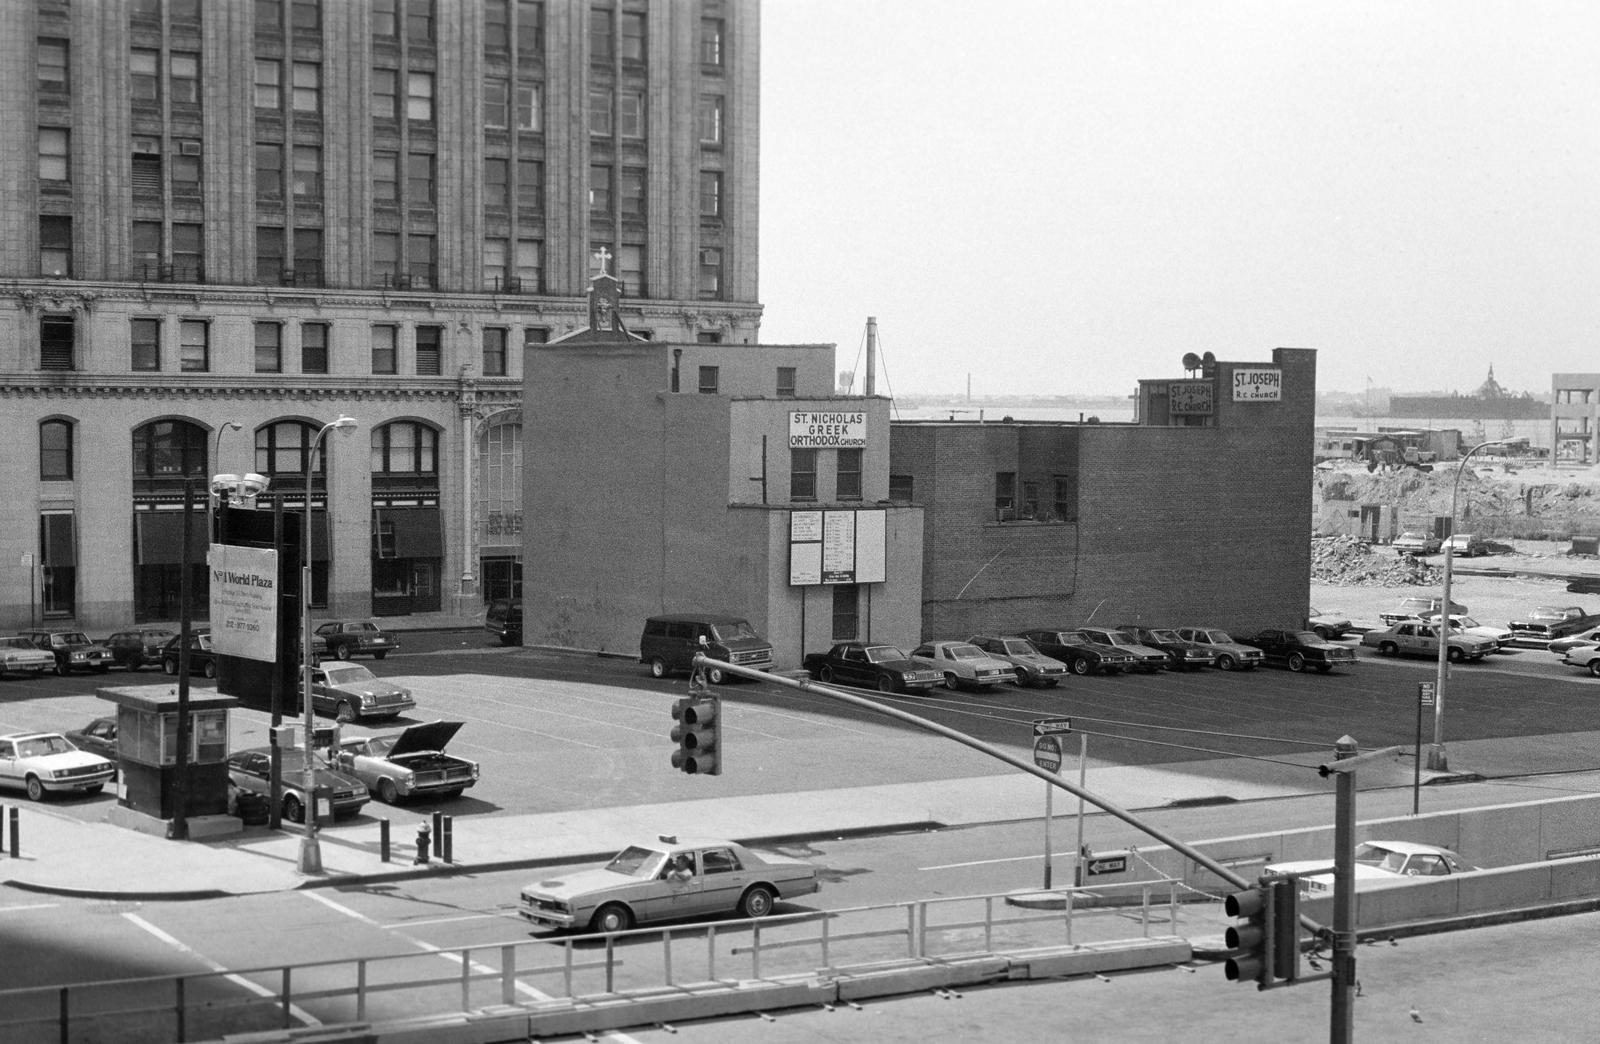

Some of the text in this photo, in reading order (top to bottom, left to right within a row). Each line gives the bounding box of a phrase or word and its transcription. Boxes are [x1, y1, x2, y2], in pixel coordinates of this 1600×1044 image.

[1247, 372, 1280, 388] JOSEPH
[1182, 385, 1212, 398] JOSEPH
[1250, 390, 1278, 399] CHURCH
[1184, 400, 1212, 412] CHURCH
[794, 413, 863, 424] ST. NICHOLAS
[808, 425, 849, 435] GREEK
[790, 435, 866, 446] ORTHODOX CHURCH
[228, 572, 250, 586] World
[251, 574, 273, 589] Plaza
[1039, 742, 1057, 752] DO NOT
[1039, 760, 1057, 770] ENTER
